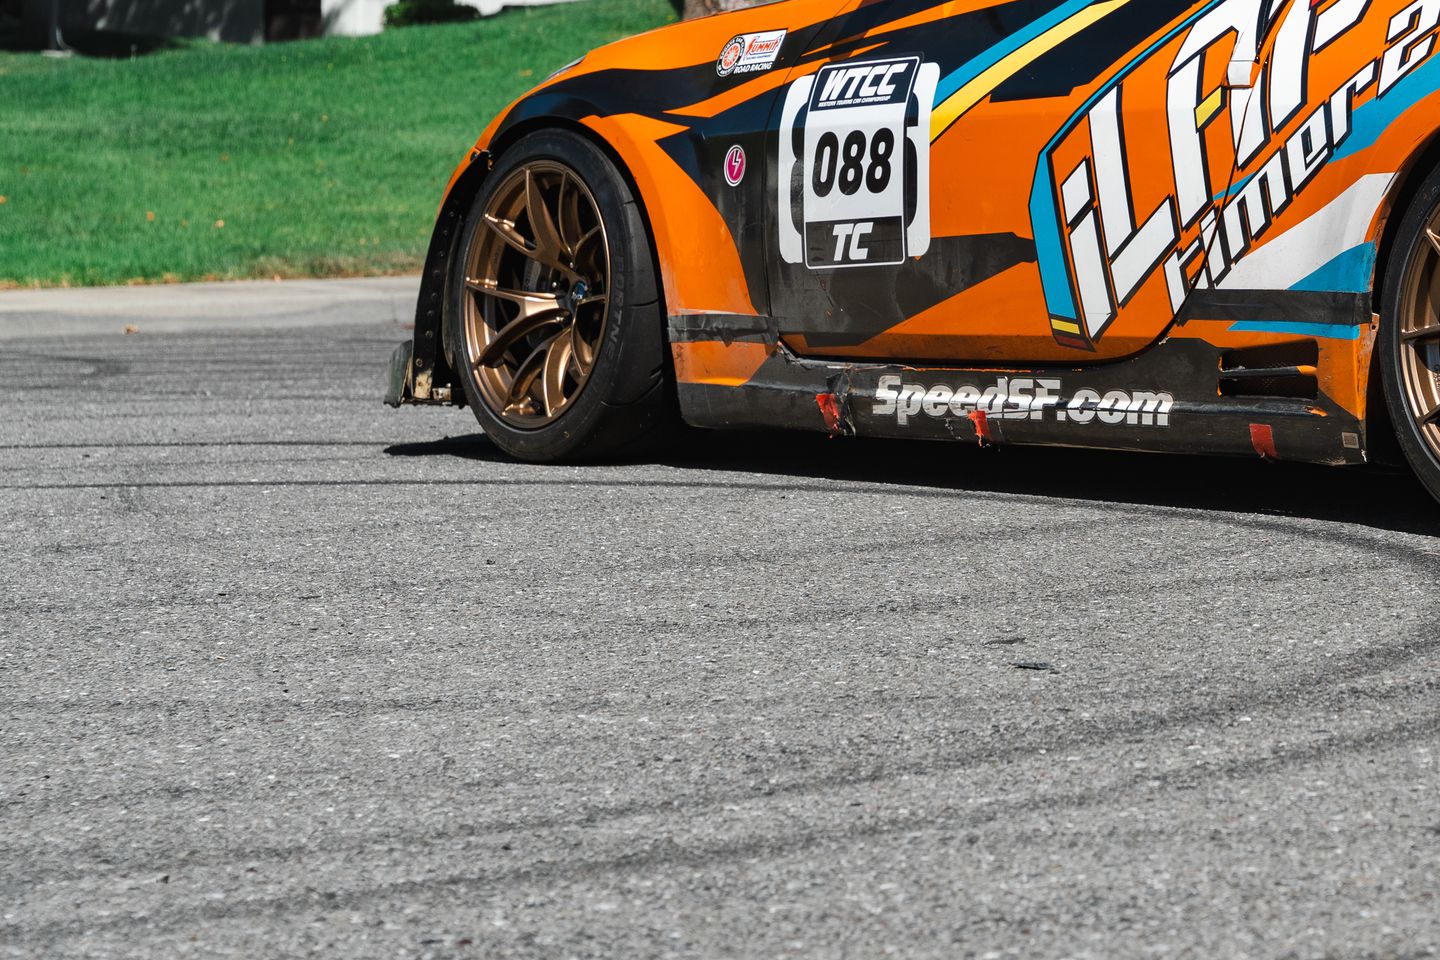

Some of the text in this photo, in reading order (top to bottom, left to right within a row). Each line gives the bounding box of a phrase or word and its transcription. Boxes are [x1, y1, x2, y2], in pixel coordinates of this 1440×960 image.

[734, 62, 773, 74] ROAD RACING
[819, 62, 909, 102] WTCC
[812, 127, 895, 198] 088
[832, 221, 874, 262] TC
[871, 374, 1174, 428] SpeedSF.com
